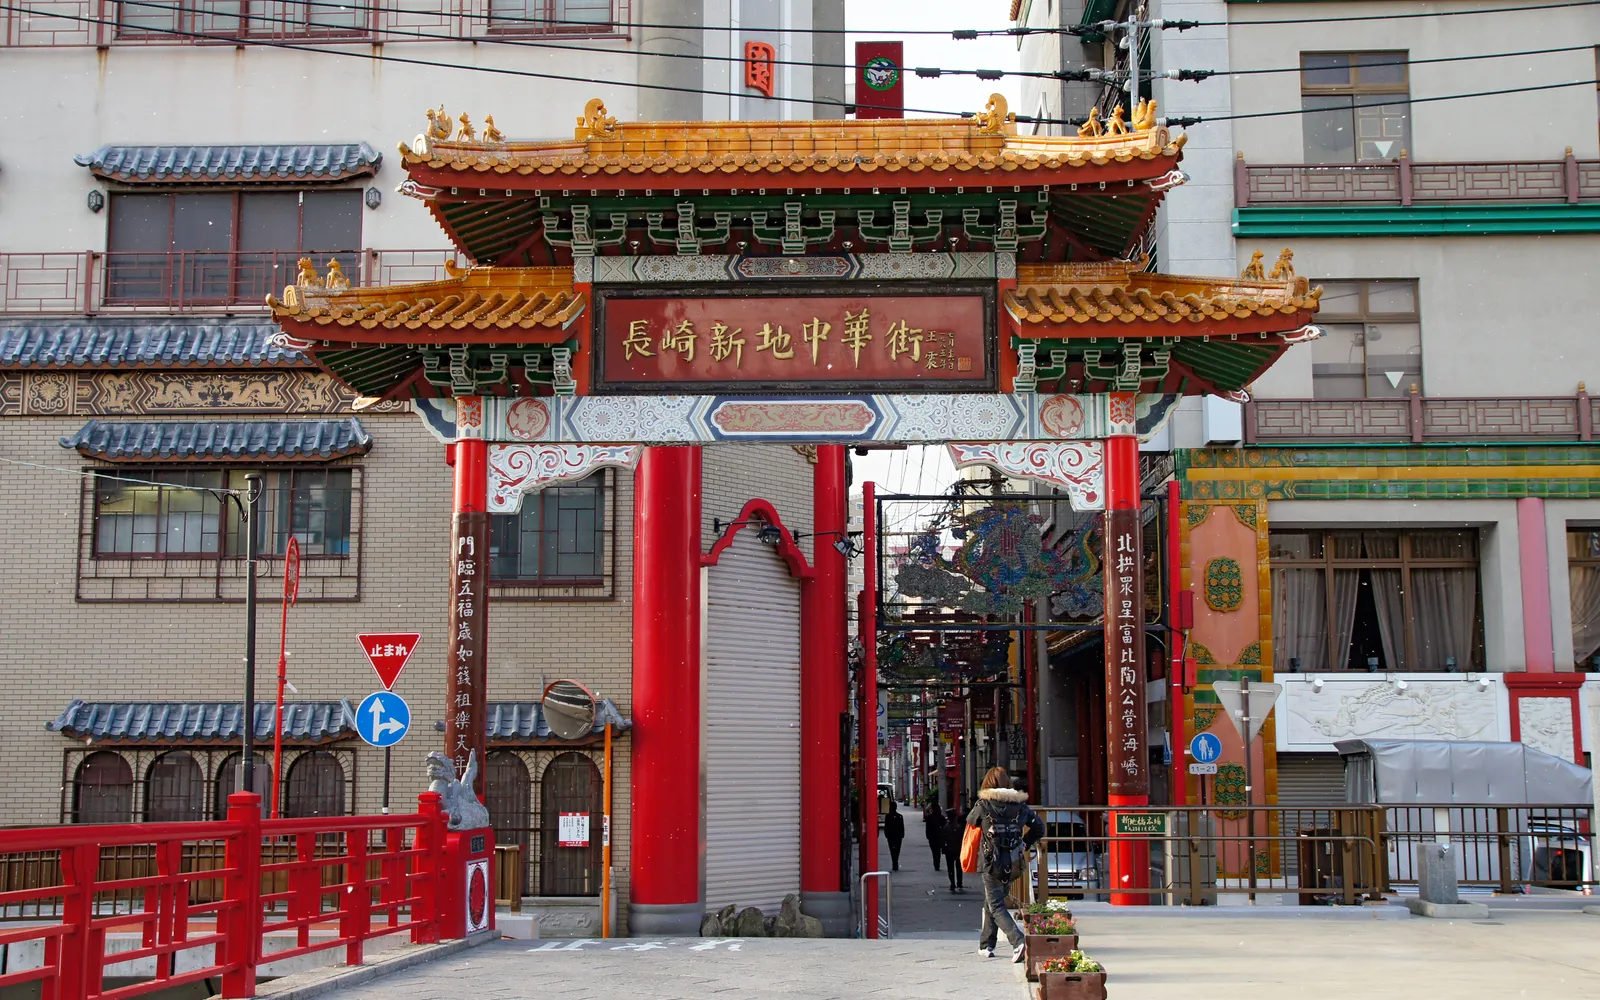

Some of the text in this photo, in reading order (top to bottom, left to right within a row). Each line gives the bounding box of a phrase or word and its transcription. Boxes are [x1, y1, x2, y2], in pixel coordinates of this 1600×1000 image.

[621, 308, 925, 370] 長崎新地中華街
[370, 643, 408, 657] 止まれ
[1191, 765, 1216, 773] 11-21
[526, 938, 746, 952] 止まれ
